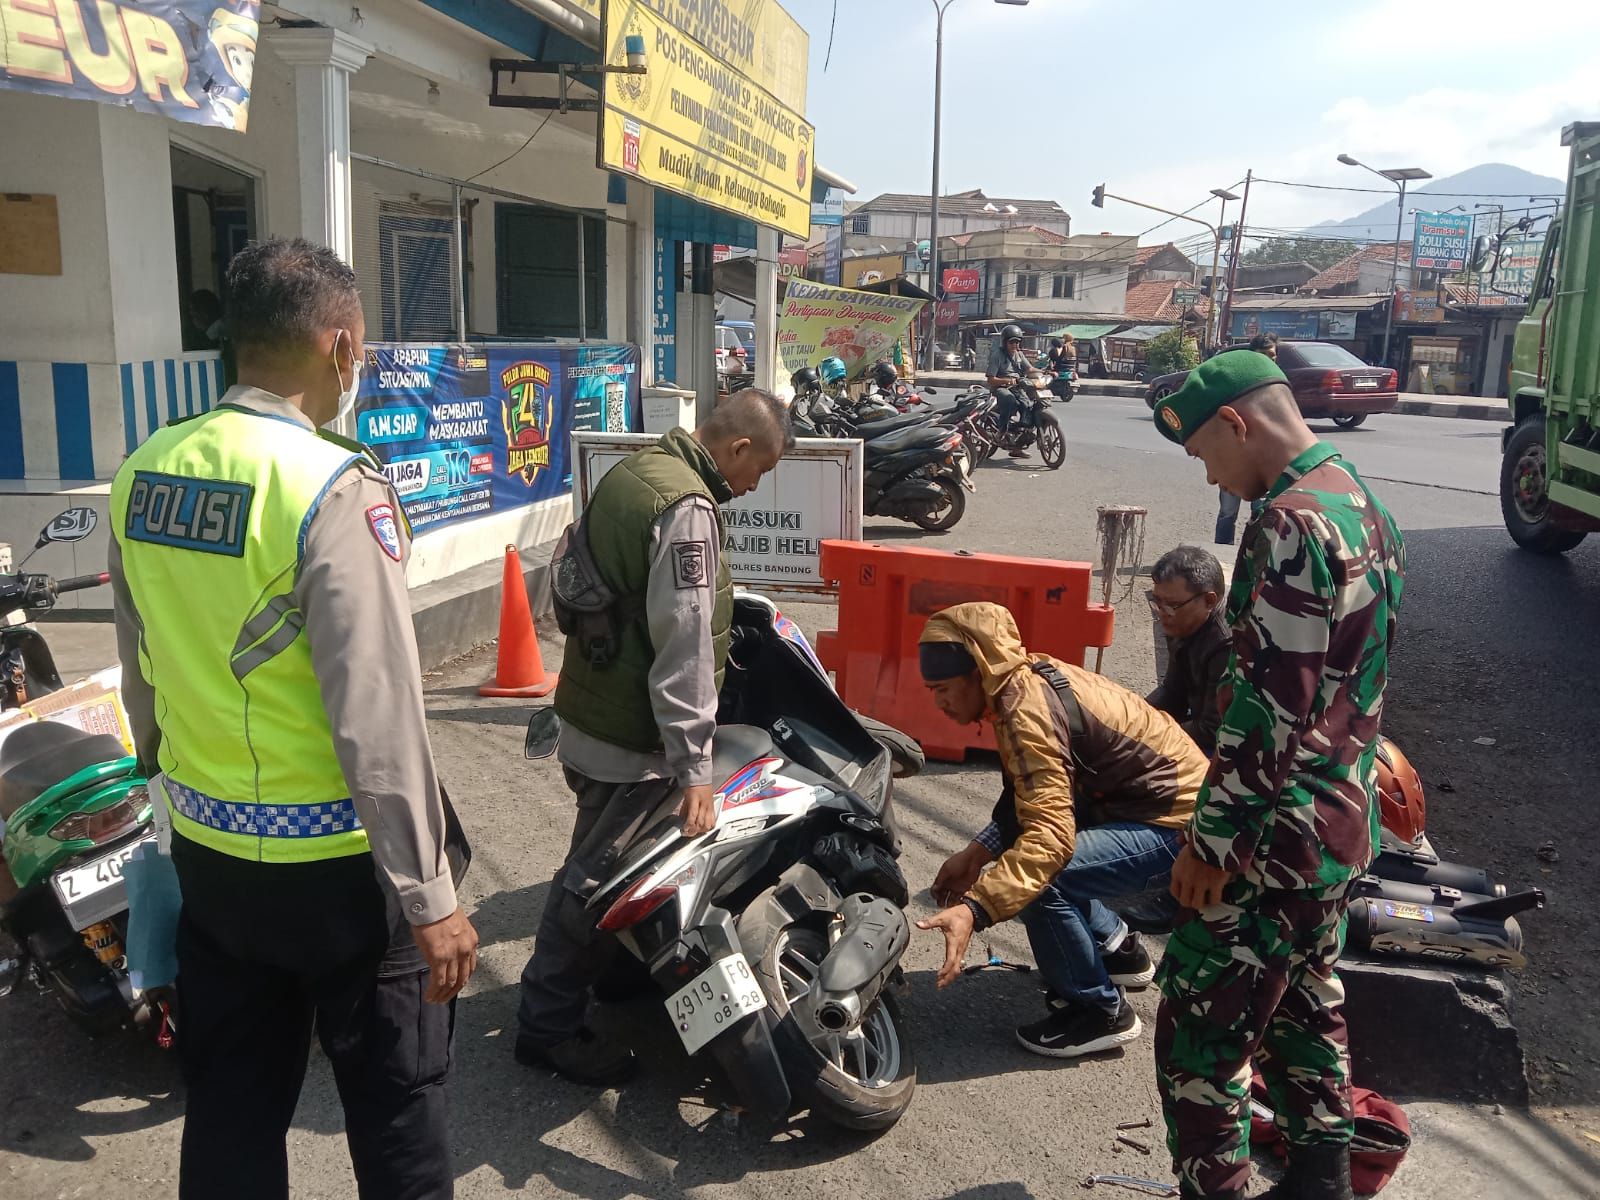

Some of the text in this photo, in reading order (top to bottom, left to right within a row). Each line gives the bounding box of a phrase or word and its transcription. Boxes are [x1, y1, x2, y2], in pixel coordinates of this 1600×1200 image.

[656, 27, 677, 63] POS
[679, 43, 741, 105] PENGAMANAN
[754, 95, 759, 116] 3
[759, 98, 796, 142] RANCAEKEK
[624, 142, 639, 167] 110
[658, 146, 786, 220] Mudik Aman, Keluarga Bahagia
[1421, 224, 1456, 236] Tiramisu
[1417, 246, 1450, 258] LEMBANG
[1419, 235, 1466, 249] BOLU SUSU
[947, 277, 976, 290] Panjo
[786, 281, 918, 313] KEDAI SAWARGI
[835, 304, 897, 325] Dangdeur
[392, 349, 429, 366] APAPUN
[795, 344, 816, 355] TAHU
[378, 370, 432, 389] SITUASINYA
[502, 366, 519, 387] POLDA
[519, 364, 534, 379] JAWA
[534, 364, 550, 384] BARAT
[432, 400, 484, 421] MEMBANTU
[392, 412, 418, 435] SIAP
[396, 462, 423, 482] JAGA
[436, 465, 448, 475] CALL
[508, 450, 525, 474] JAGA
[128, 478, 243, 547] POLISI
[721, 509, 802, 530] MASUKI
[724, 534, 771, 554] AJIB
[776, 536, 821, 557] HEL
[764, 565, 812, 575] BANDUNG
[61, 875, 82, 898] Z
[675, 980, 714, 1021] 4919
